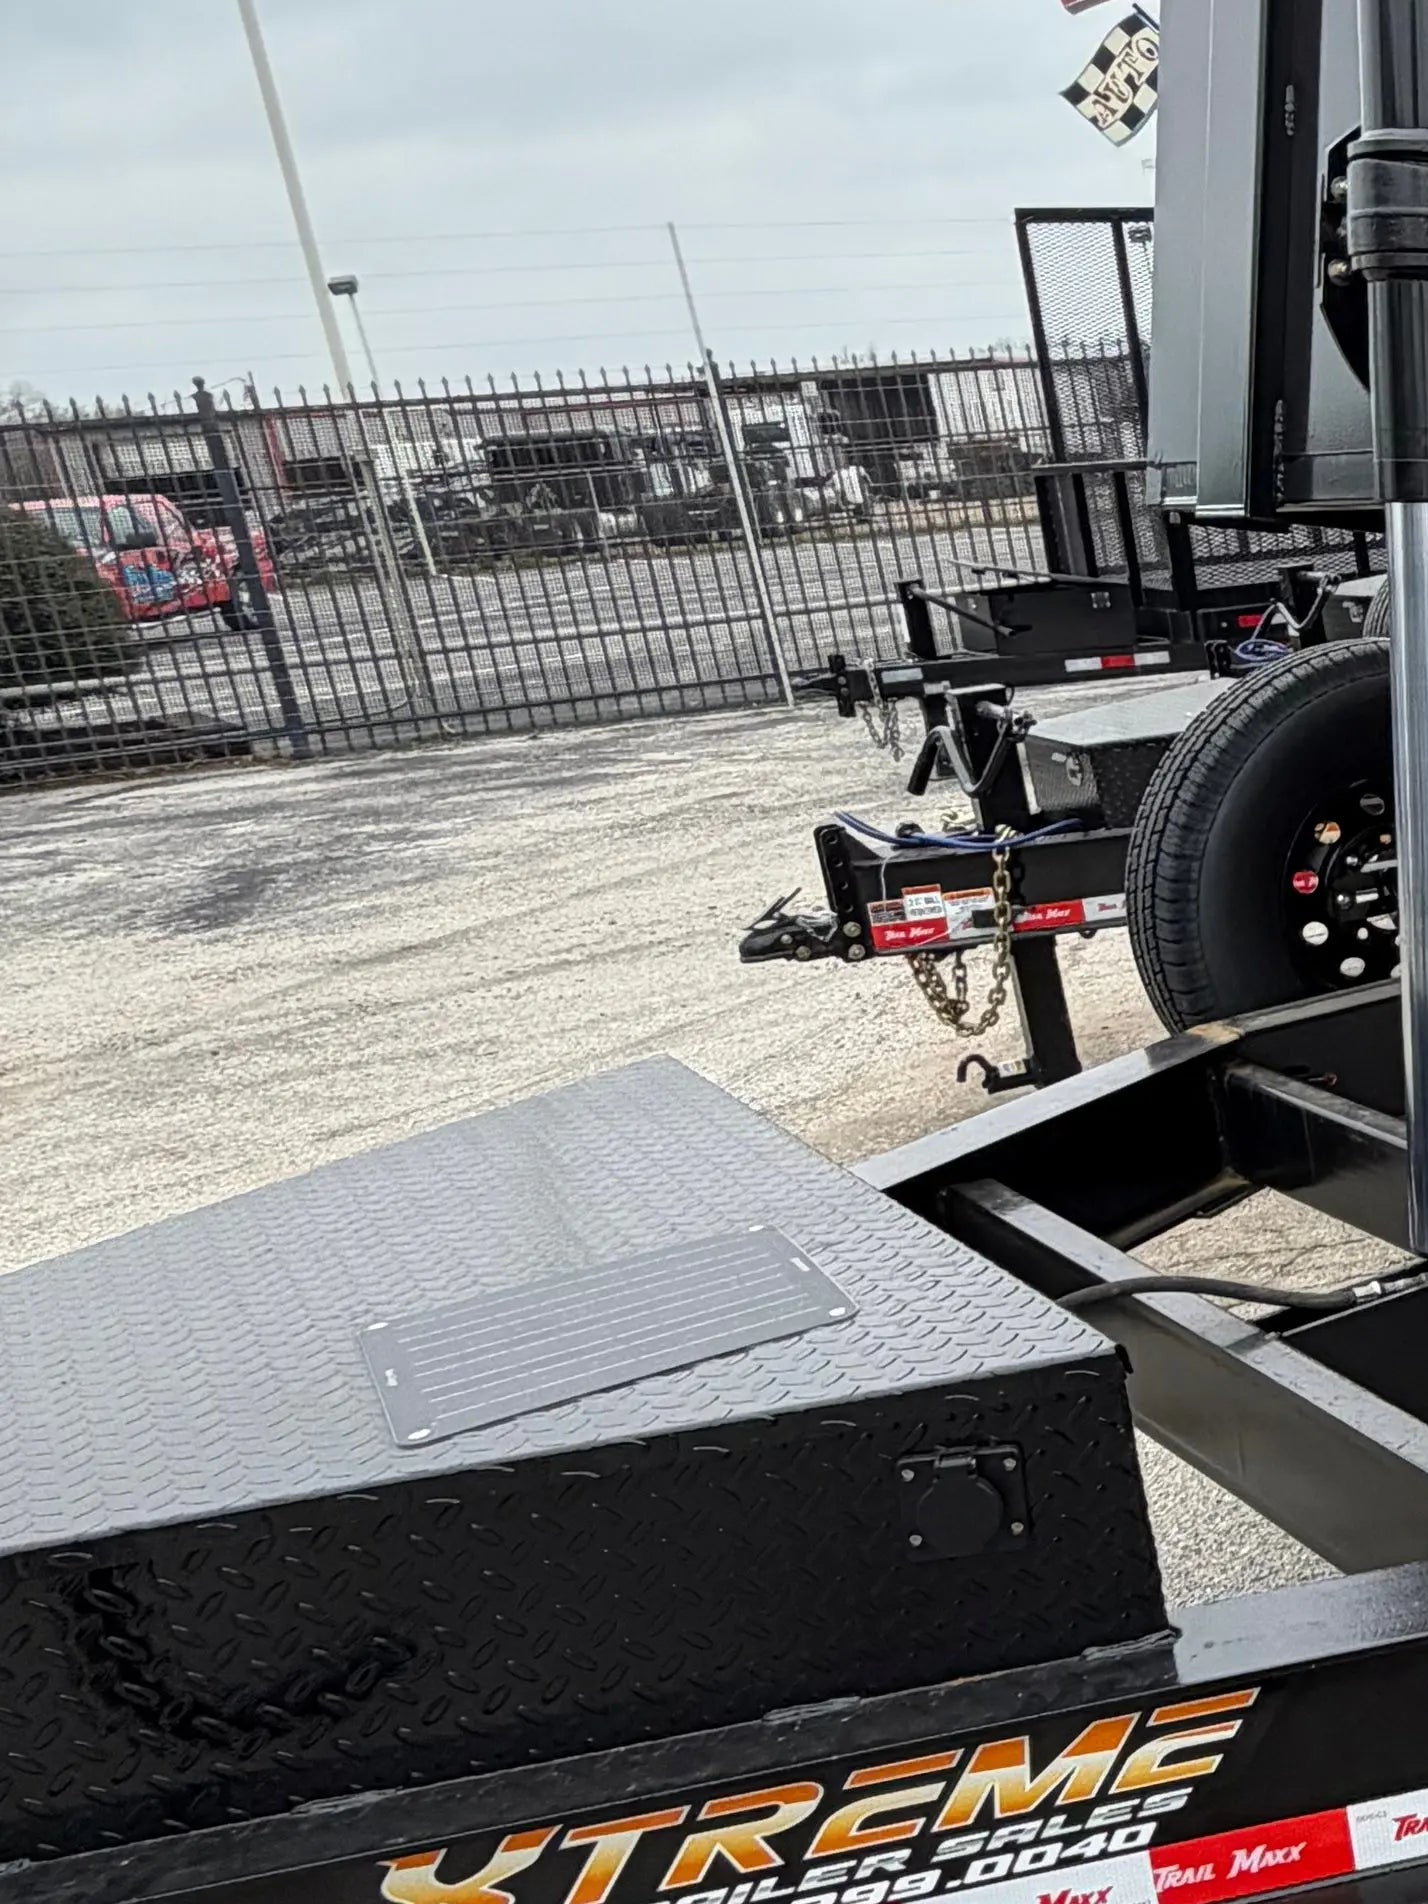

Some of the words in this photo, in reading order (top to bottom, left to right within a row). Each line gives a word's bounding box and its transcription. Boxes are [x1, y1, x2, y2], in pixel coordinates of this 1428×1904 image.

[1094, 35, 1160, 128] AUTO
[930, 1787, 1193, 1865] SALES
[1154, 1859, 1217, 1893] TRAIL
[1226, 1840, 1307, 1881] MAXX
